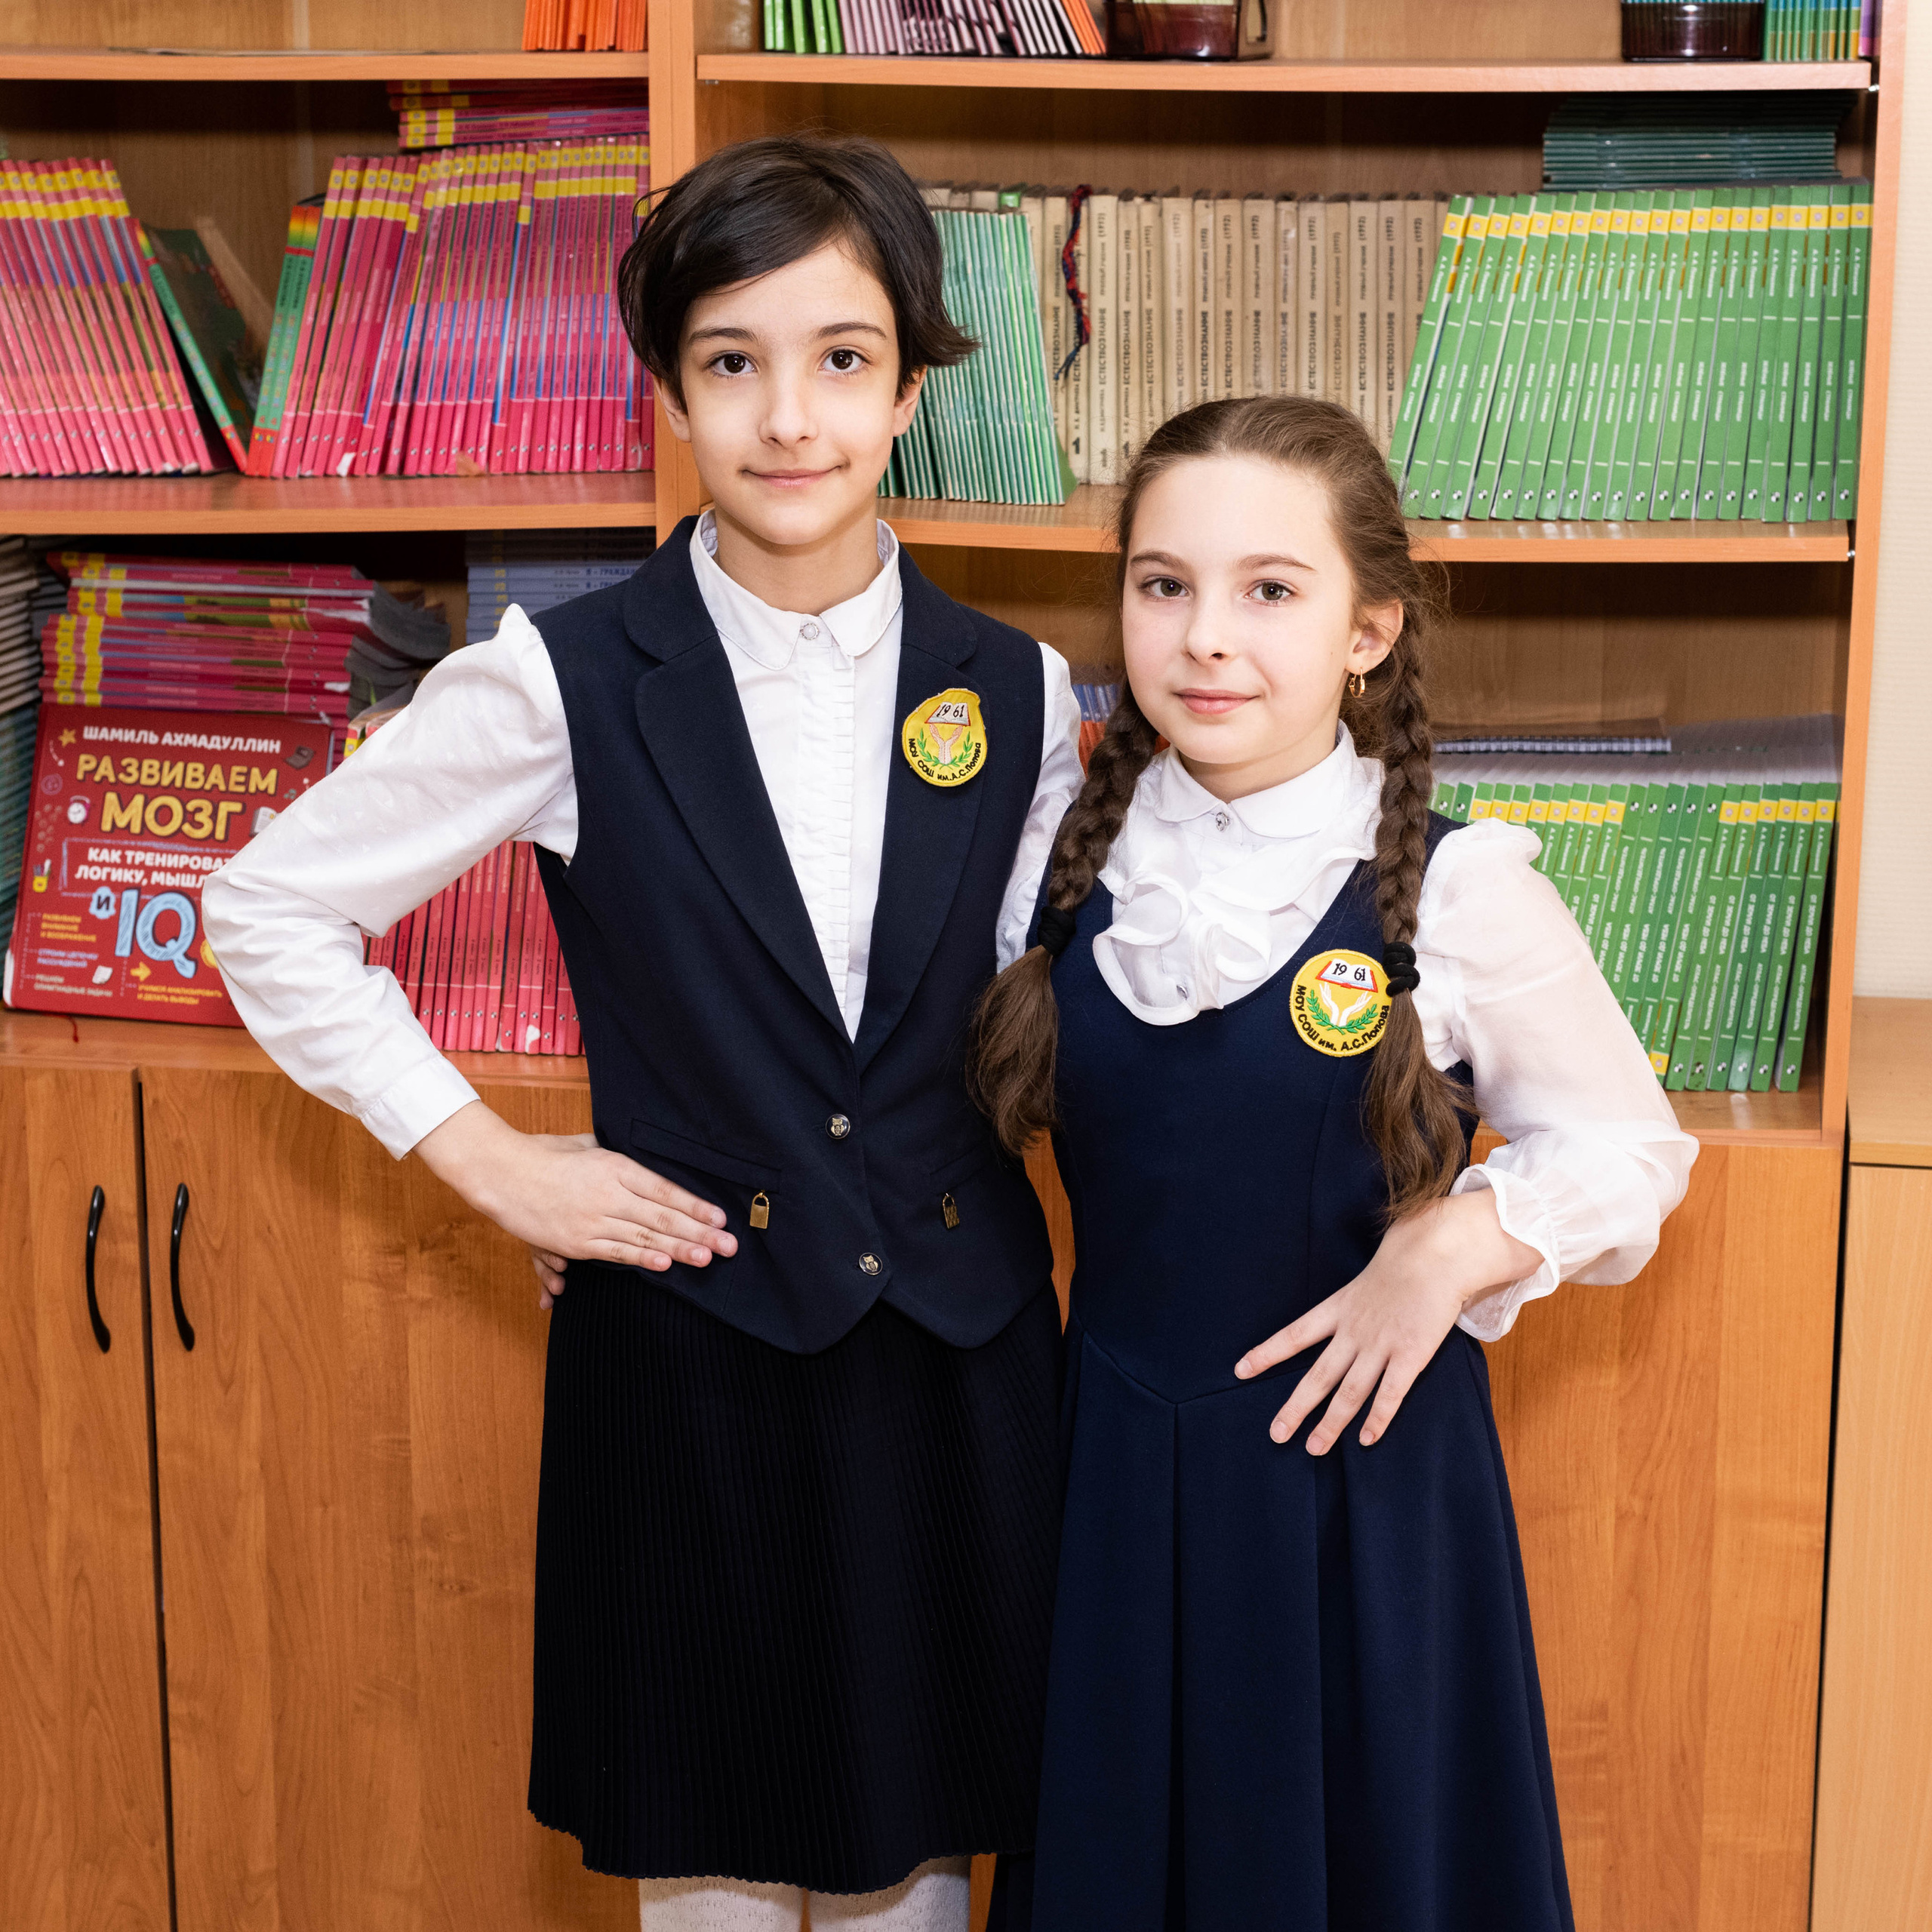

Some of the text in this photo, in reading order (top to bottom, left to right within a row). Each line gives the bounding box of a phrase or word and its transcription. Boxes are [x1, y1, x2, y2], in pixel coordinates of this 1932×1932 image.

[83, 726, 281, 753] ШАМИЛЬ АХМАДУЛЛИН
[908, 738, 919, 758] МОУ
[917, 759, 935, 777] СОШ
[76, 753, 279, 795] РАЗВИВАЕМ
[100, 791, 245, 841] МОЗГ
[88, 847, 122, 863] КАК
[75, 864, 148, 886] ЛОГИКУ,
[115, 888, 196, 979] IQ
[1294, 984, 1307, 1011] МОУ
[1298, 1014, 1320, 1041] СОШ
